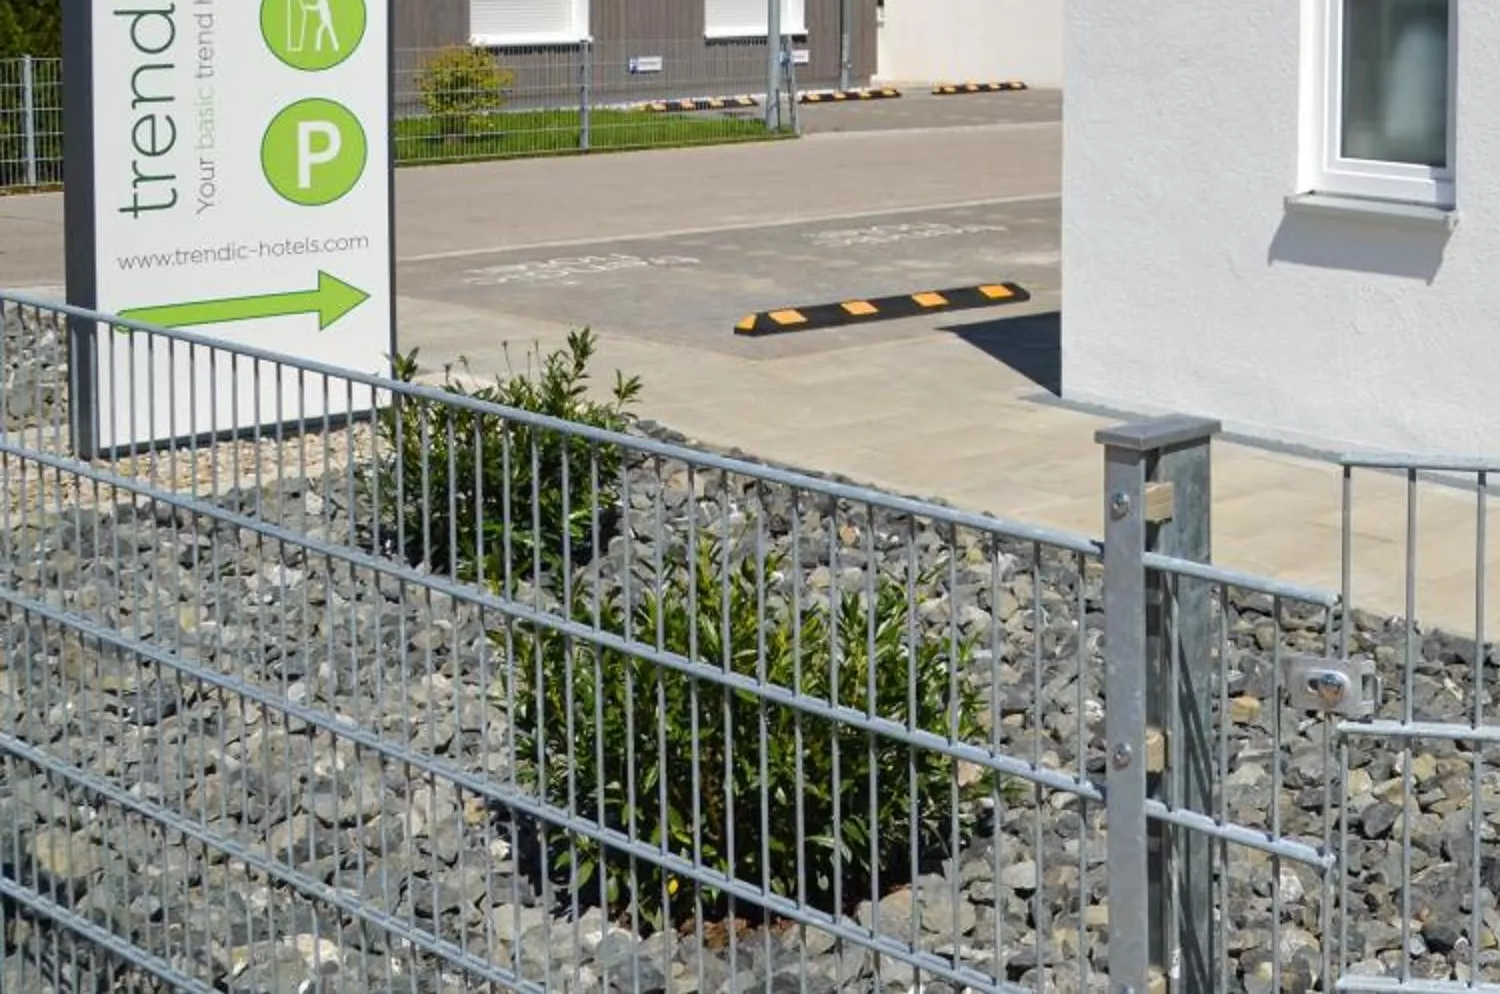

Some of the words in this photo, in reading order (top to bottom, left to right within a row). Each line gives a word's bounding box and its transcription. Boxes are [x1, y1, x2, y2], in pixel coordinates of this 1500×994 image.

[193, 12, 215, 79] trend
[194, 85, 215, 150] basic
[195, 156, 215, 215] Your
[296, 120, 342, 190] P
[117, 234, 370, 271] www.trendic-hotels.com
